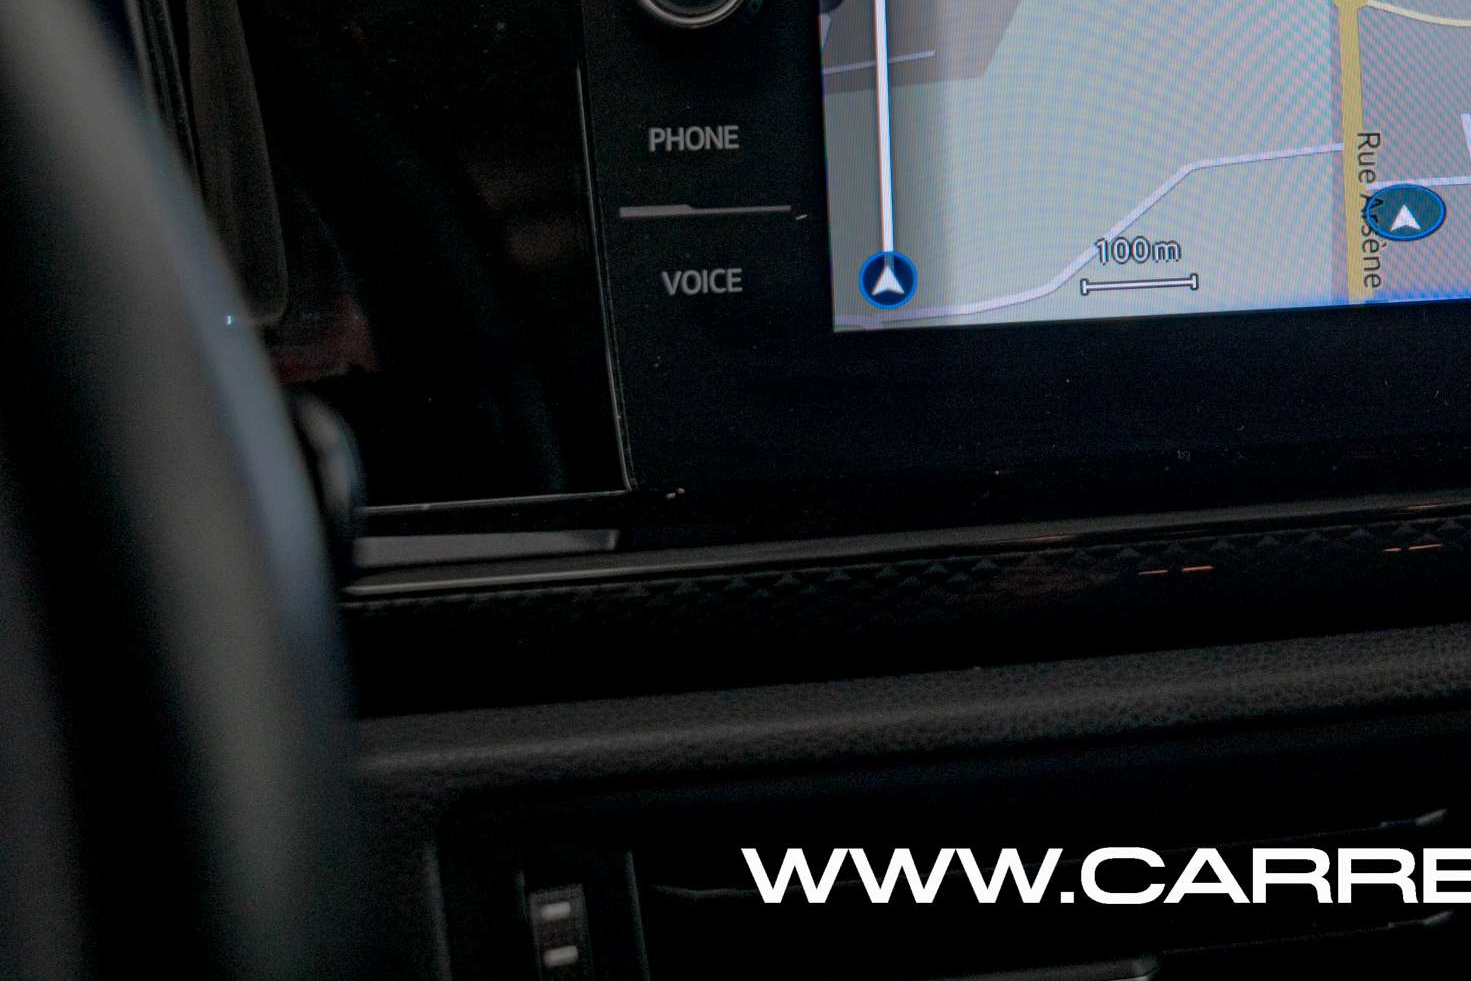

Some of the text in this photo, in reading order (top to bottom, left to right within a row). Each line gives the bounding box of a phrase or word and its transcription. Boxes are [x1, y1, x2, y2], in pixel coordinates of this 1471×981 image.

[648, 124, 740, 152] PHONE
[1356, 131, 1381, 184] Rue
[1094, 235, 1183, 266] 100m
[661, 267, 743, 296] VOICE
